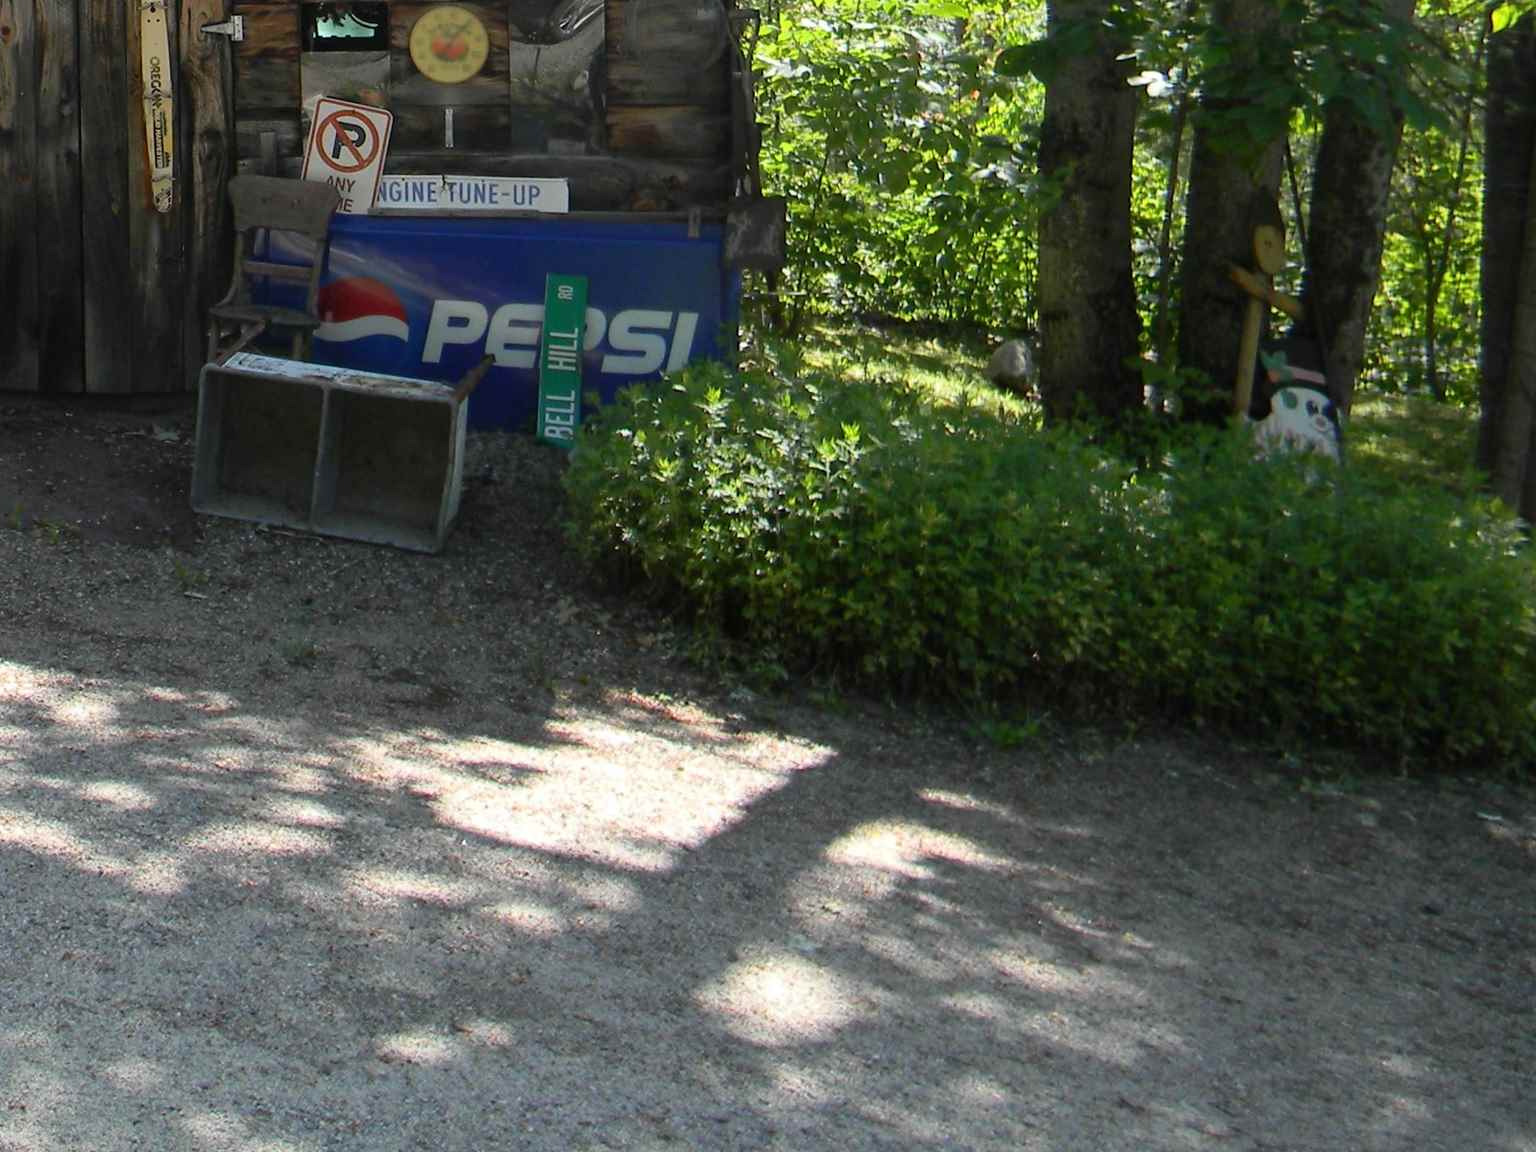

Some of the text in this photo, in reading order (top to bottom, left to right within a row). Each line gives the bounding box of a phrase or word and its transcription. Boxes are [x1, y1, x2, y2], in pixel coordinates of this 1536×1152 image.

[327, 175, 356, 193] ANY
[377, 180, 541, 206] NGINE TUNE-UP
[544, 284, 579, 440] BELL HILL RD
